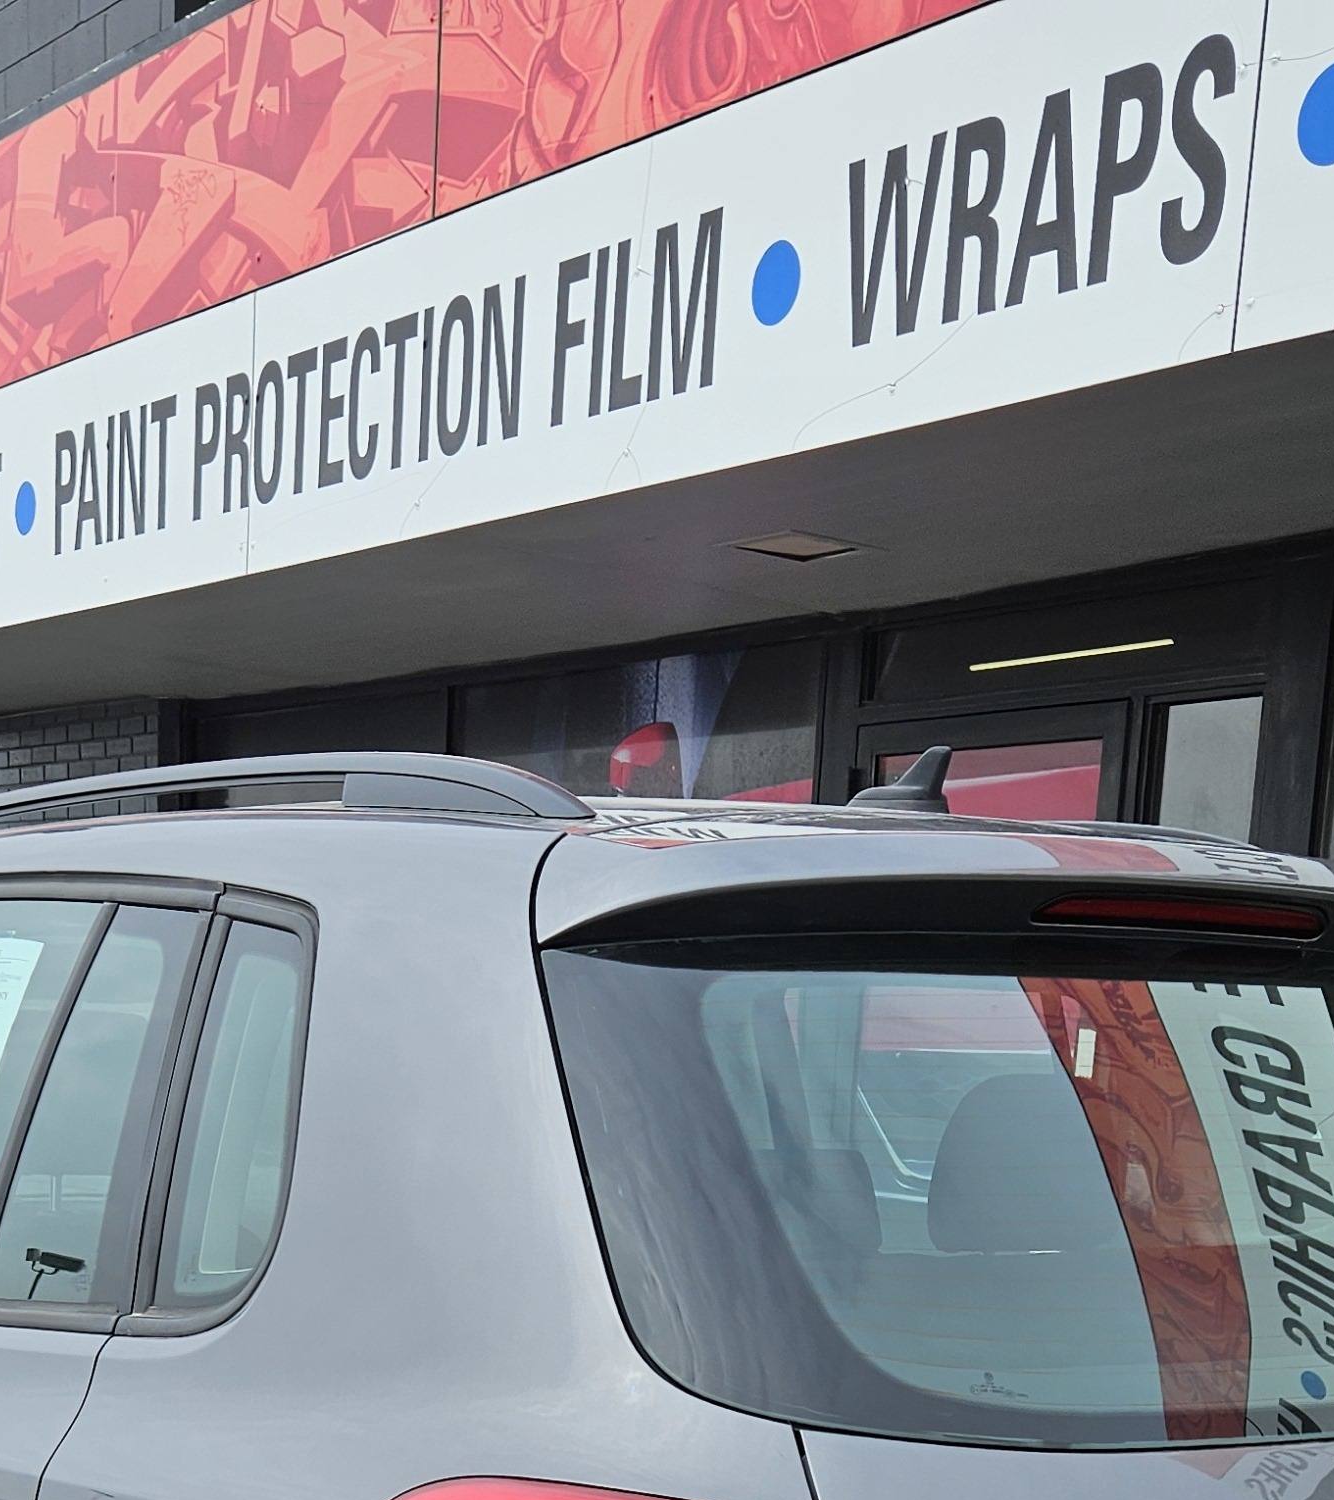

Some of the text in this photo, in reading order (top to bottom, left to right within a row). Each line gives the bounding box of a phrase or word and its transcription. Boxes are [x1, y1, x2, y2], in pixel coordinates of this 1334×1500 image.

[54, 395, 177, 556] PAINT
[192, 274, 527, 522] PROTECTION
[551, 206, 724, 428] FILM
[849, 33, 1237, 348] WRAPS
